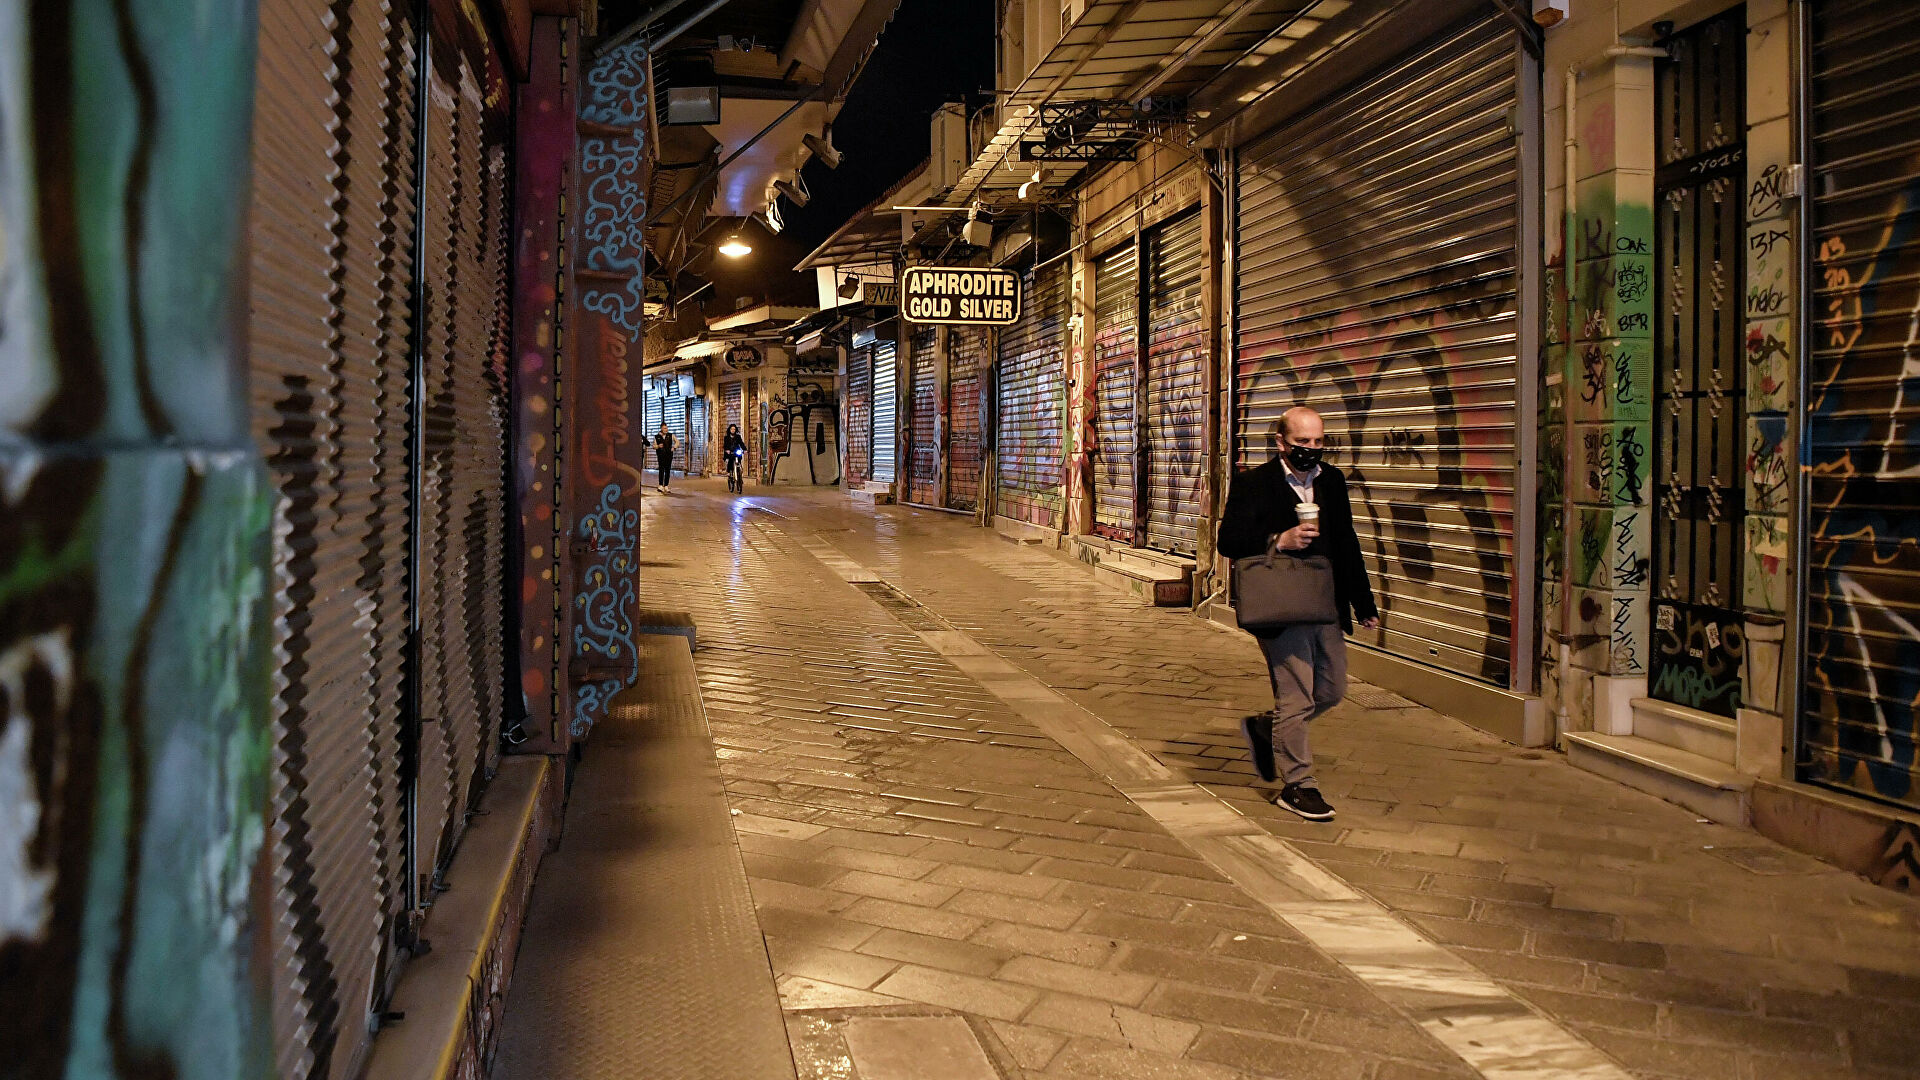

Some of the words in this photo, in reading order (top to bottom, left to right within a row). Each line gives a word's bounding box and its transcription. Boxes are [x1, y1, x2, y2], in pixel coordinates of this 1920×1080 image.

[909, 272, 1015, 297] APHRODITE
[910, 297, 952, 317] GOLD
[959, 298, 1013, 319] SILVER
